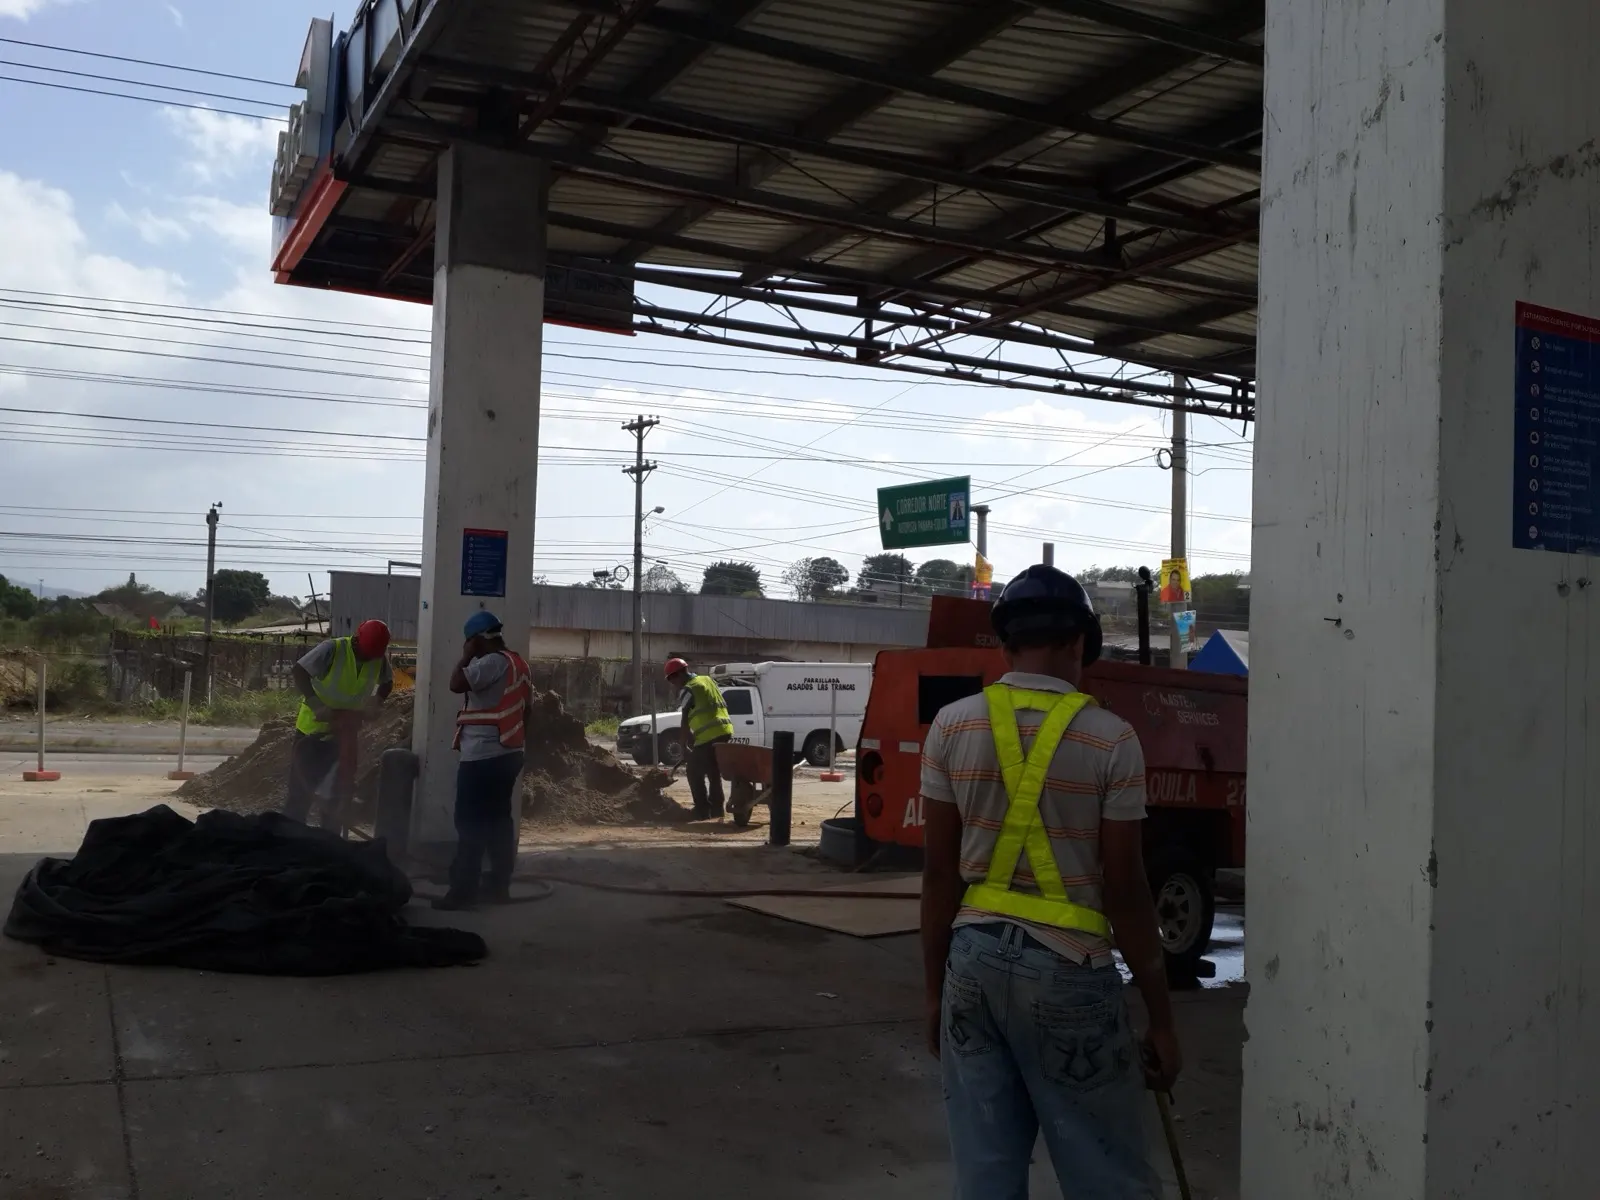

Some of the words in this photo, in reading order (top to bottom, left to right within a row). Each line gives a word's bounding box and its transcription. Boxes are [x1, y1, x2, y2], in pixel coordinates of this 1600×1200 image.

[896, 495, 927, 515] CORREDOR
[928, 493, 947, 511] NORTE
[1185, 592, 1190, 600] 2
[786, 683, 814, 691] ASADOS
[817, 683, 829, 691] LAS
[1177, 710, 1220, 726] SERVICES
[1148, 771, 1197, 804] QUILA
